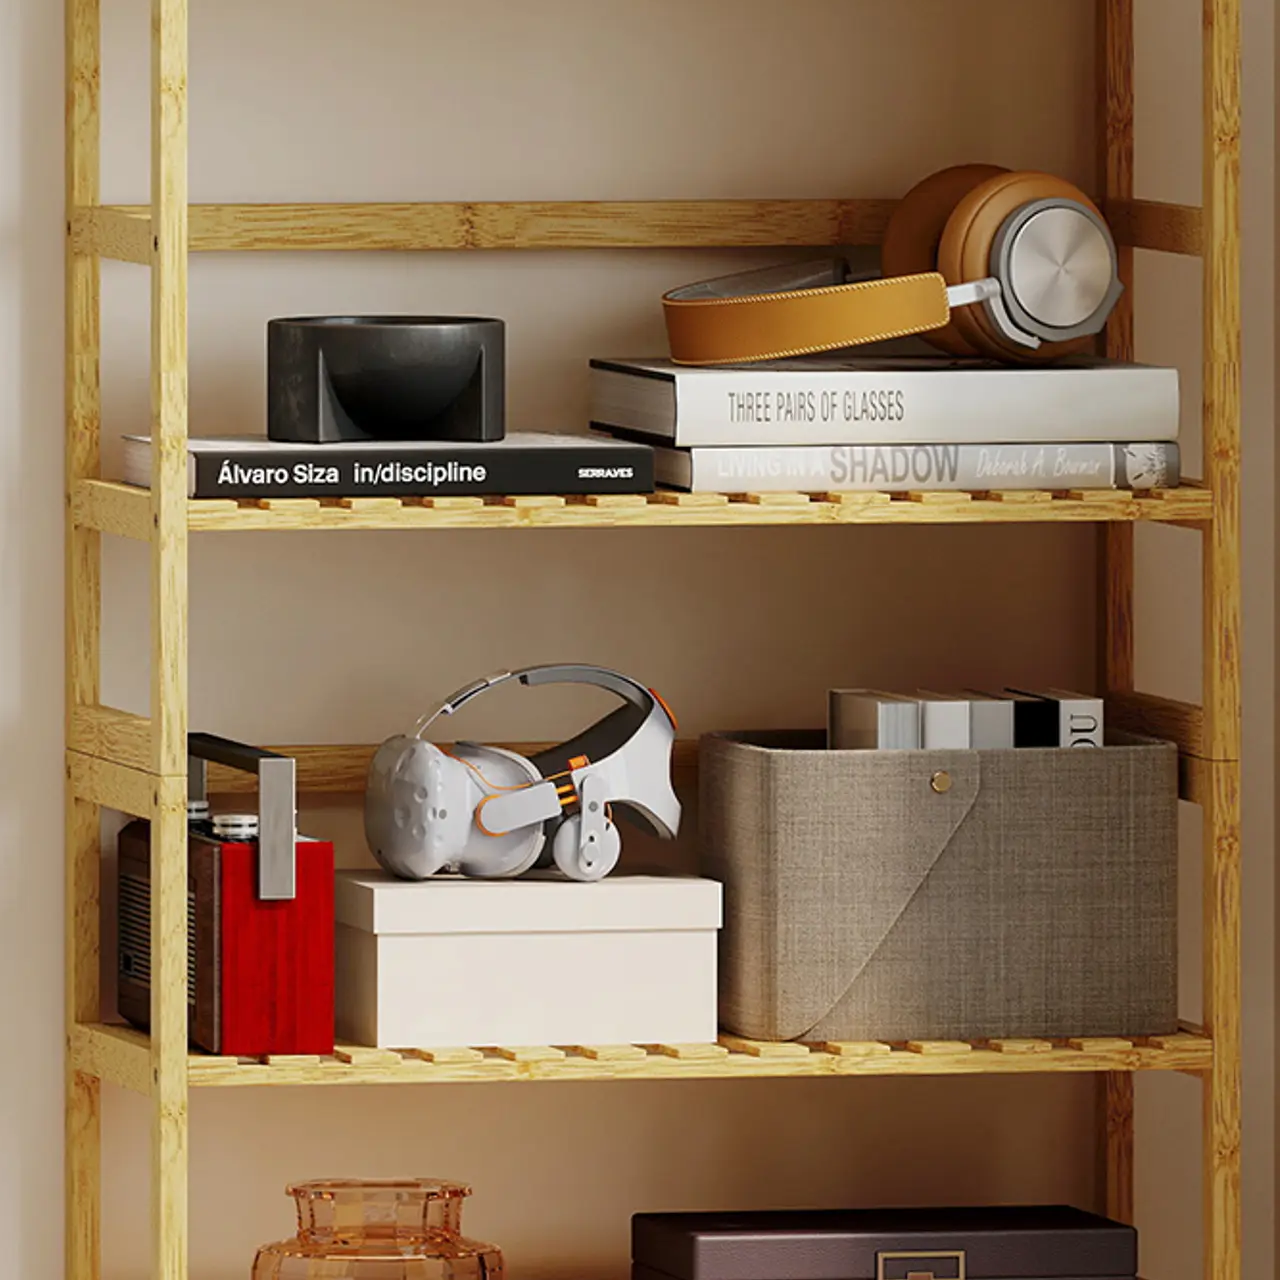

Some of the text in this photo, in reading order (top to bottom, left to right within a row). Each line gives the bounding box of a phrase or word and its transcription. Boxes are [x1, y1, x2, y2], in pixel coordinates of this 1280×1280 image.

[728, 390, 905, 423] THREE PAIRS OF GLASSES
[217, 460, 487, 487] Álvaro Siza in/discipline
[717, 452, 782, 477] LIVING
[829, 445, 960, 483] SHADOW
